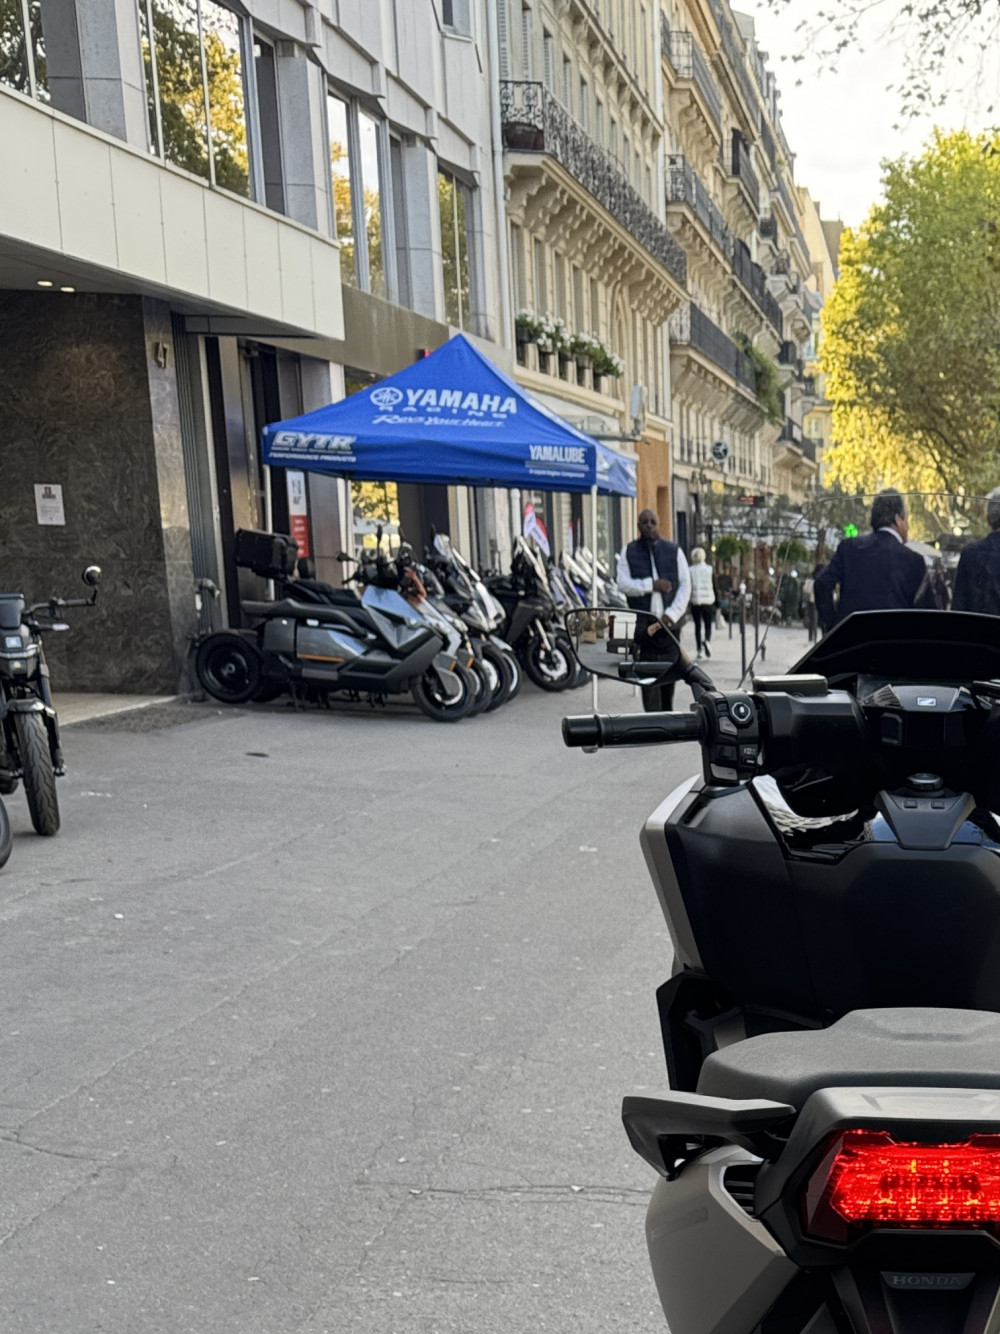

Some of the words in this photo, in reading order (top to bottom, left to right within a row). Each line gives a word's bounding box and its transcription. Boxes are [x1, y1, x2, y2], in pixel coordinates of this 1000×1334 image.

[406, 388, 518, 415] YAMAHA
[272, 430, 357, 450] GYTR
[529, 445, 586, 463] YAMALUBE
[892, 1275, 961, 1286] HONDA
